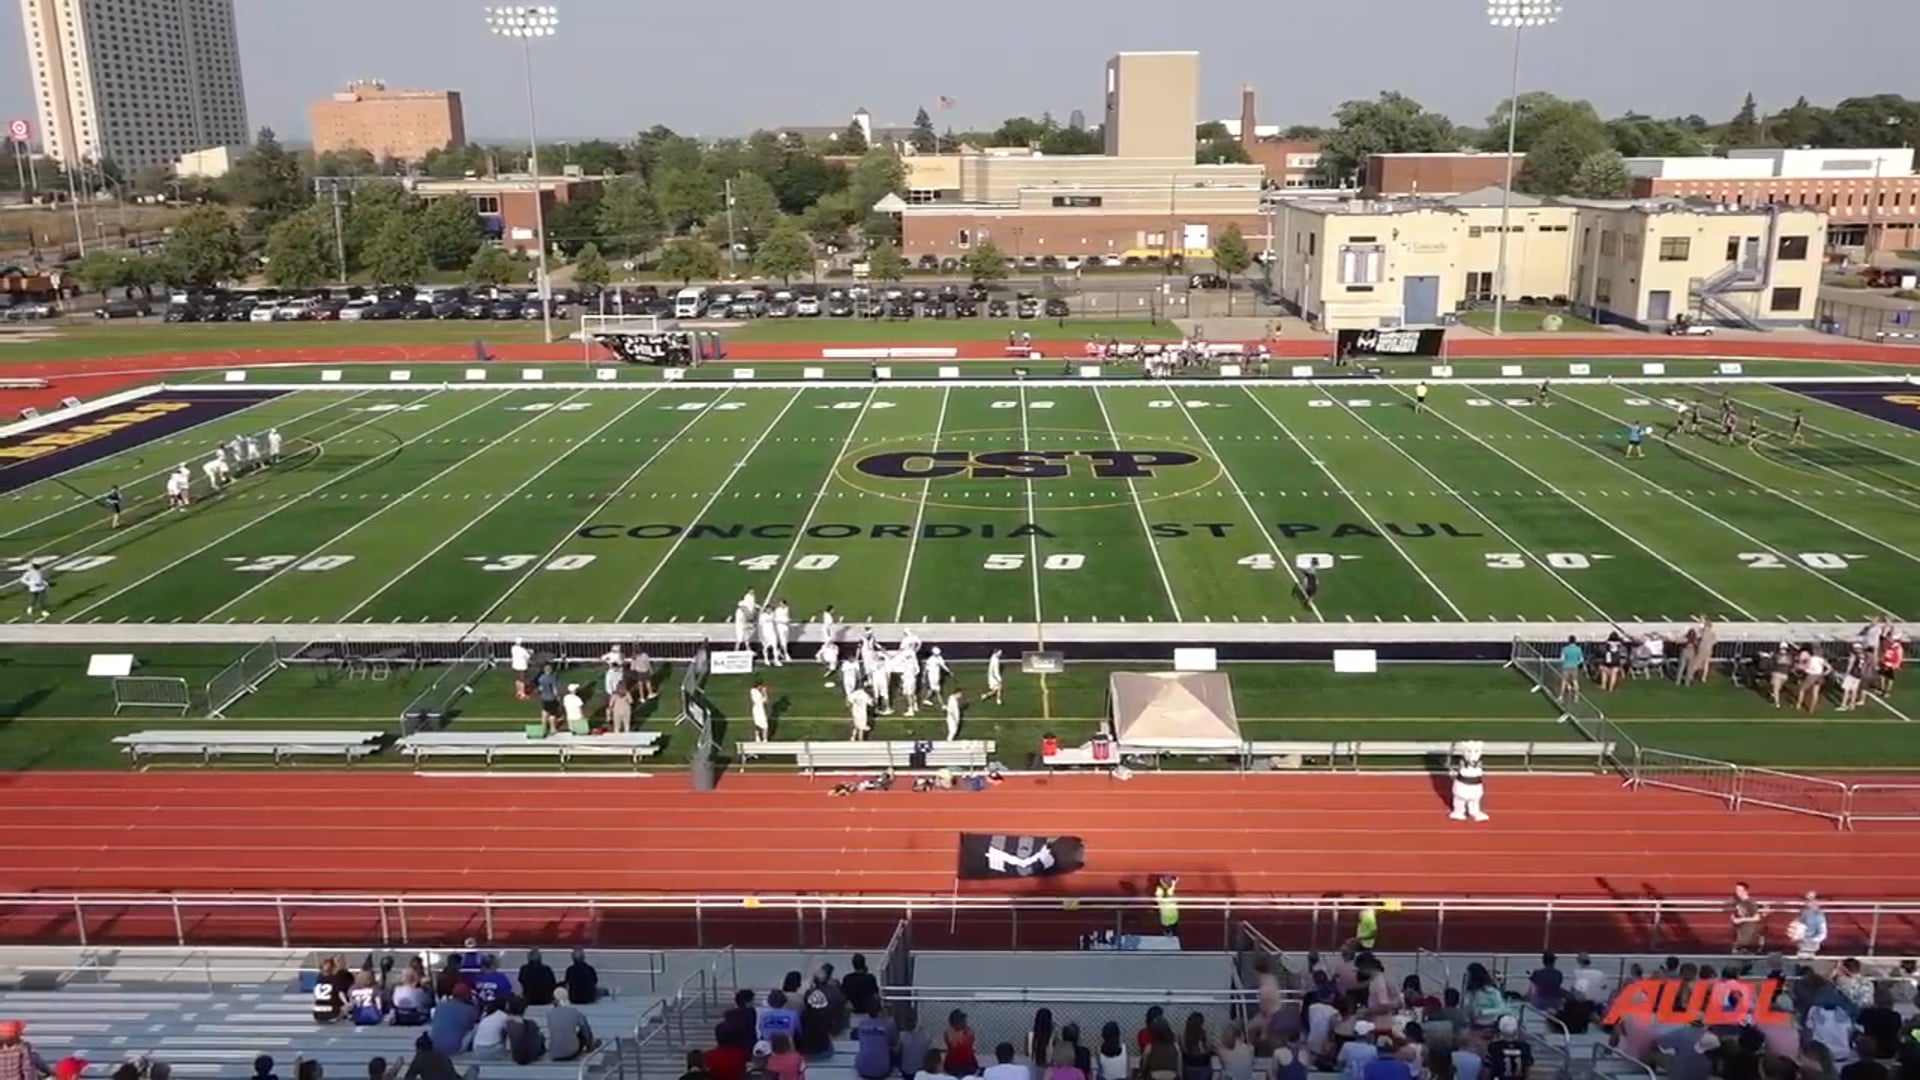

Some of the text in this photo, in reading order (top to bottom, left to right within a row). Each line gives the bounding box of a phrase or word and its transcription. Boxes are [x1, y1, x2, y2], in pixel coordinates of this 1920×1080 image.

[852, 450, 1203, 479] CSP
[576, 522, 1484, 539] CONCORDIA ST PAUL
[234, 554, 356, 571] 20
[482, 554, 597, 571] 30
[738, 554, 841, 571] 40
[983, 553, 1086, 570] 50
[1237, 553, 1335, 570] 40
[1484, 552, 1592, 569] 30
[1737, 552, 1850, 569] 20
